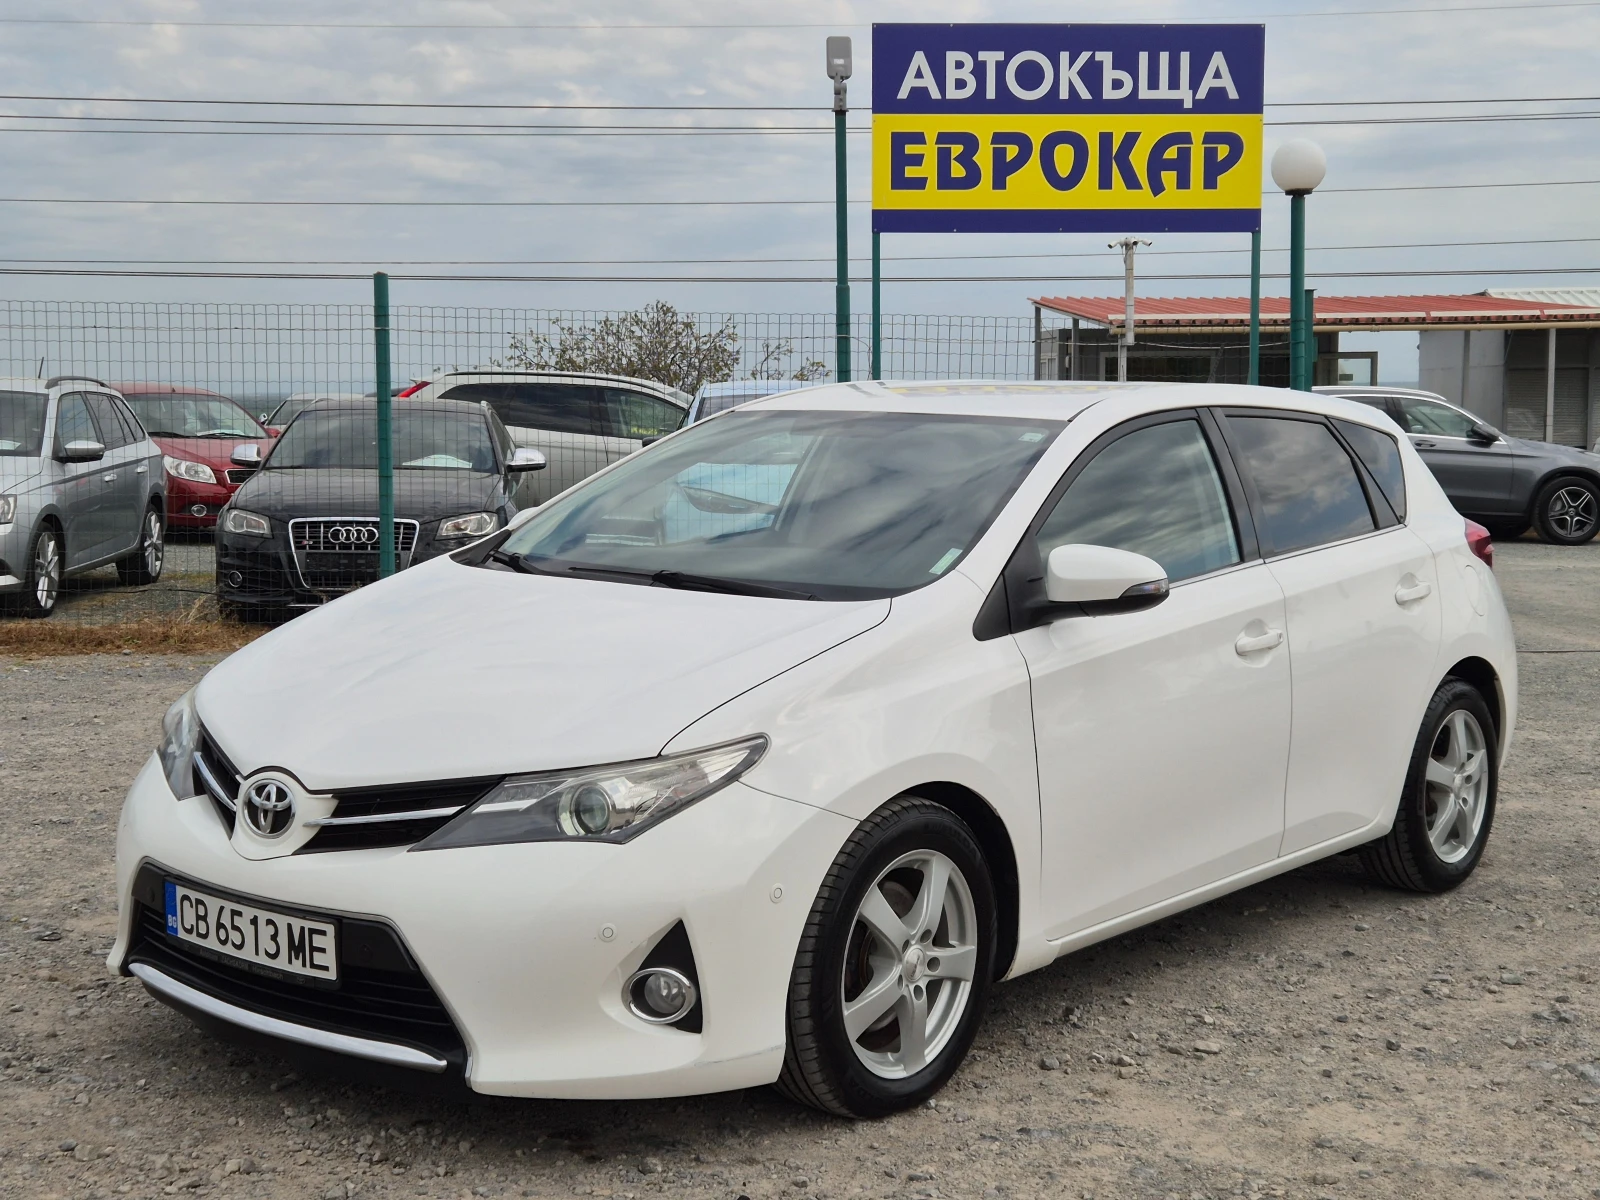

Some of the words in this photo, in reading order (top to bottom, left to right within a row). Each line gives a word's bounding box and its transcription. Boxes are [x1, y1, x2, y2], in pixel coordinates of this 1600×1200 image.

[897, 50, 1239, 109] АВТОКЪЩА
[890, 130, 1244, 198] ЕВРОКАР
[167, 914, 178, 929] BG
